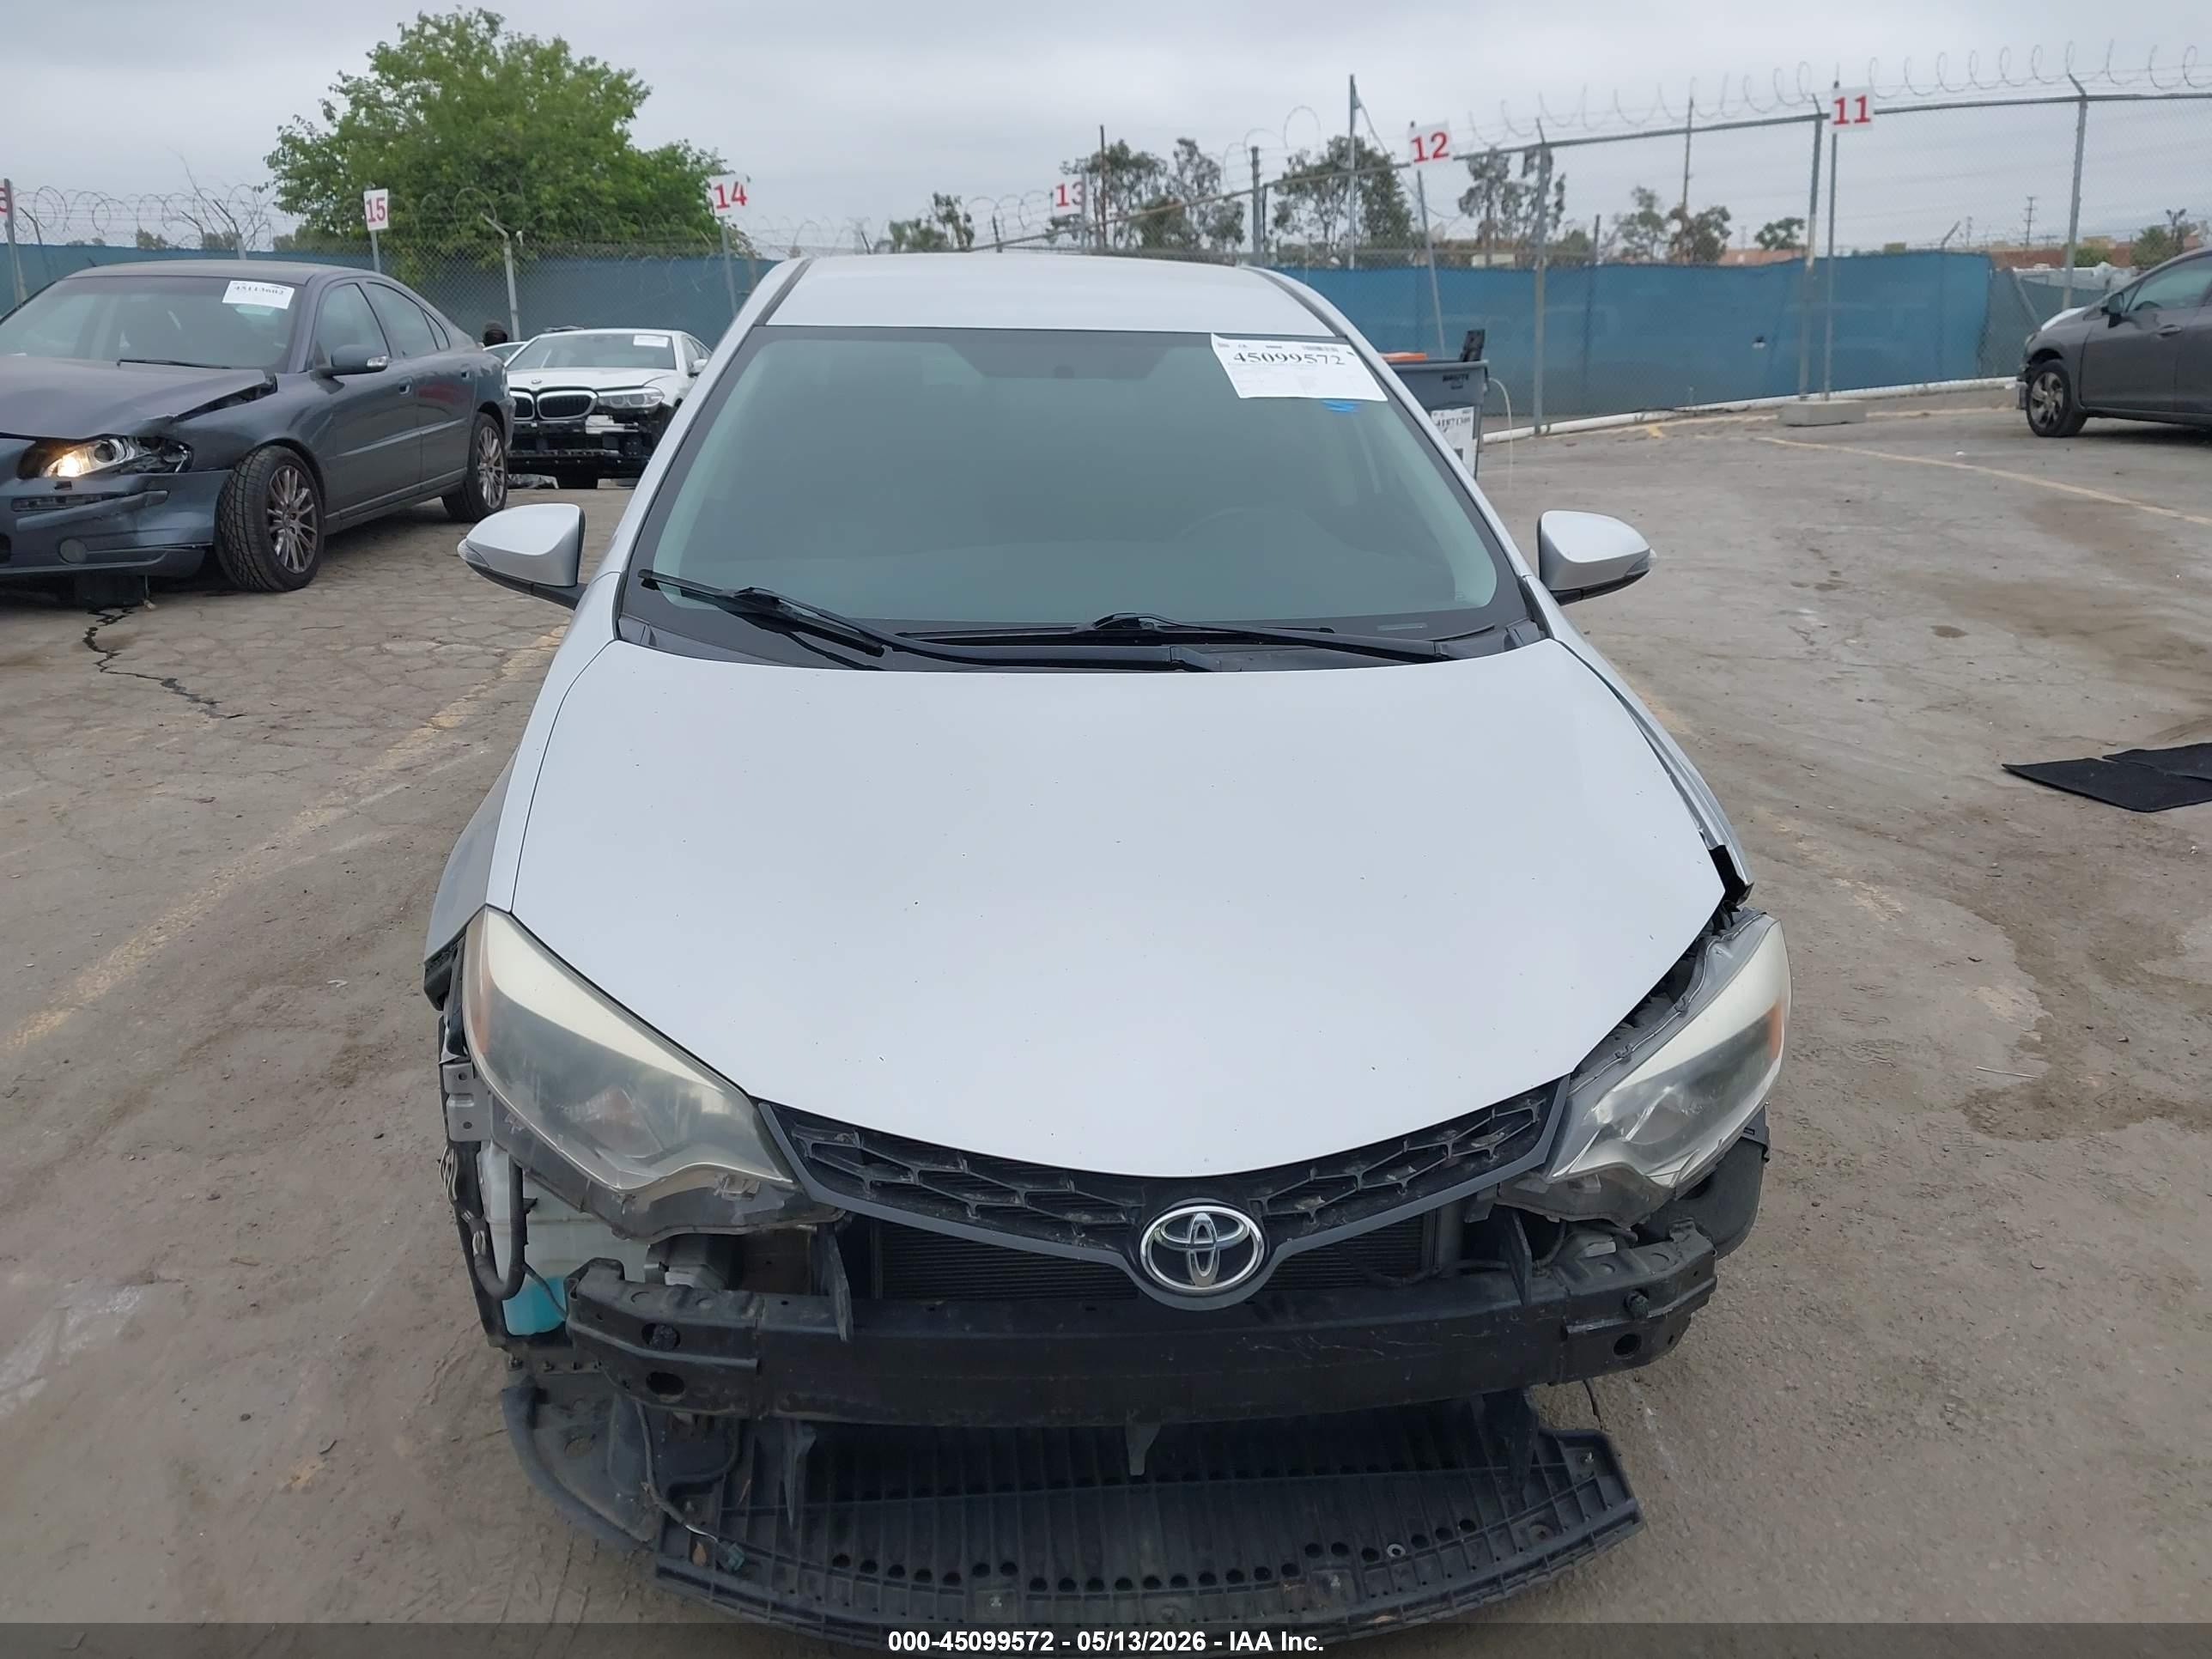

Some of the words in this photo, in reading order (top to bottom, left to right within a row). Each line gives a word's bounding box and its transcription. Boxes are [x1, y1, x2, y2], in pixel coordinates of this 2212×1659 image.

[1832, 94, 1871, 125] 11
[1411, 131, 1449, 163] 12
[714, 180, 747, 210] 14
[1056, 180, 1085, 207] 13
[366, 197, 386, 223] 15
[1233, 352, 1346, 366] 45099572
